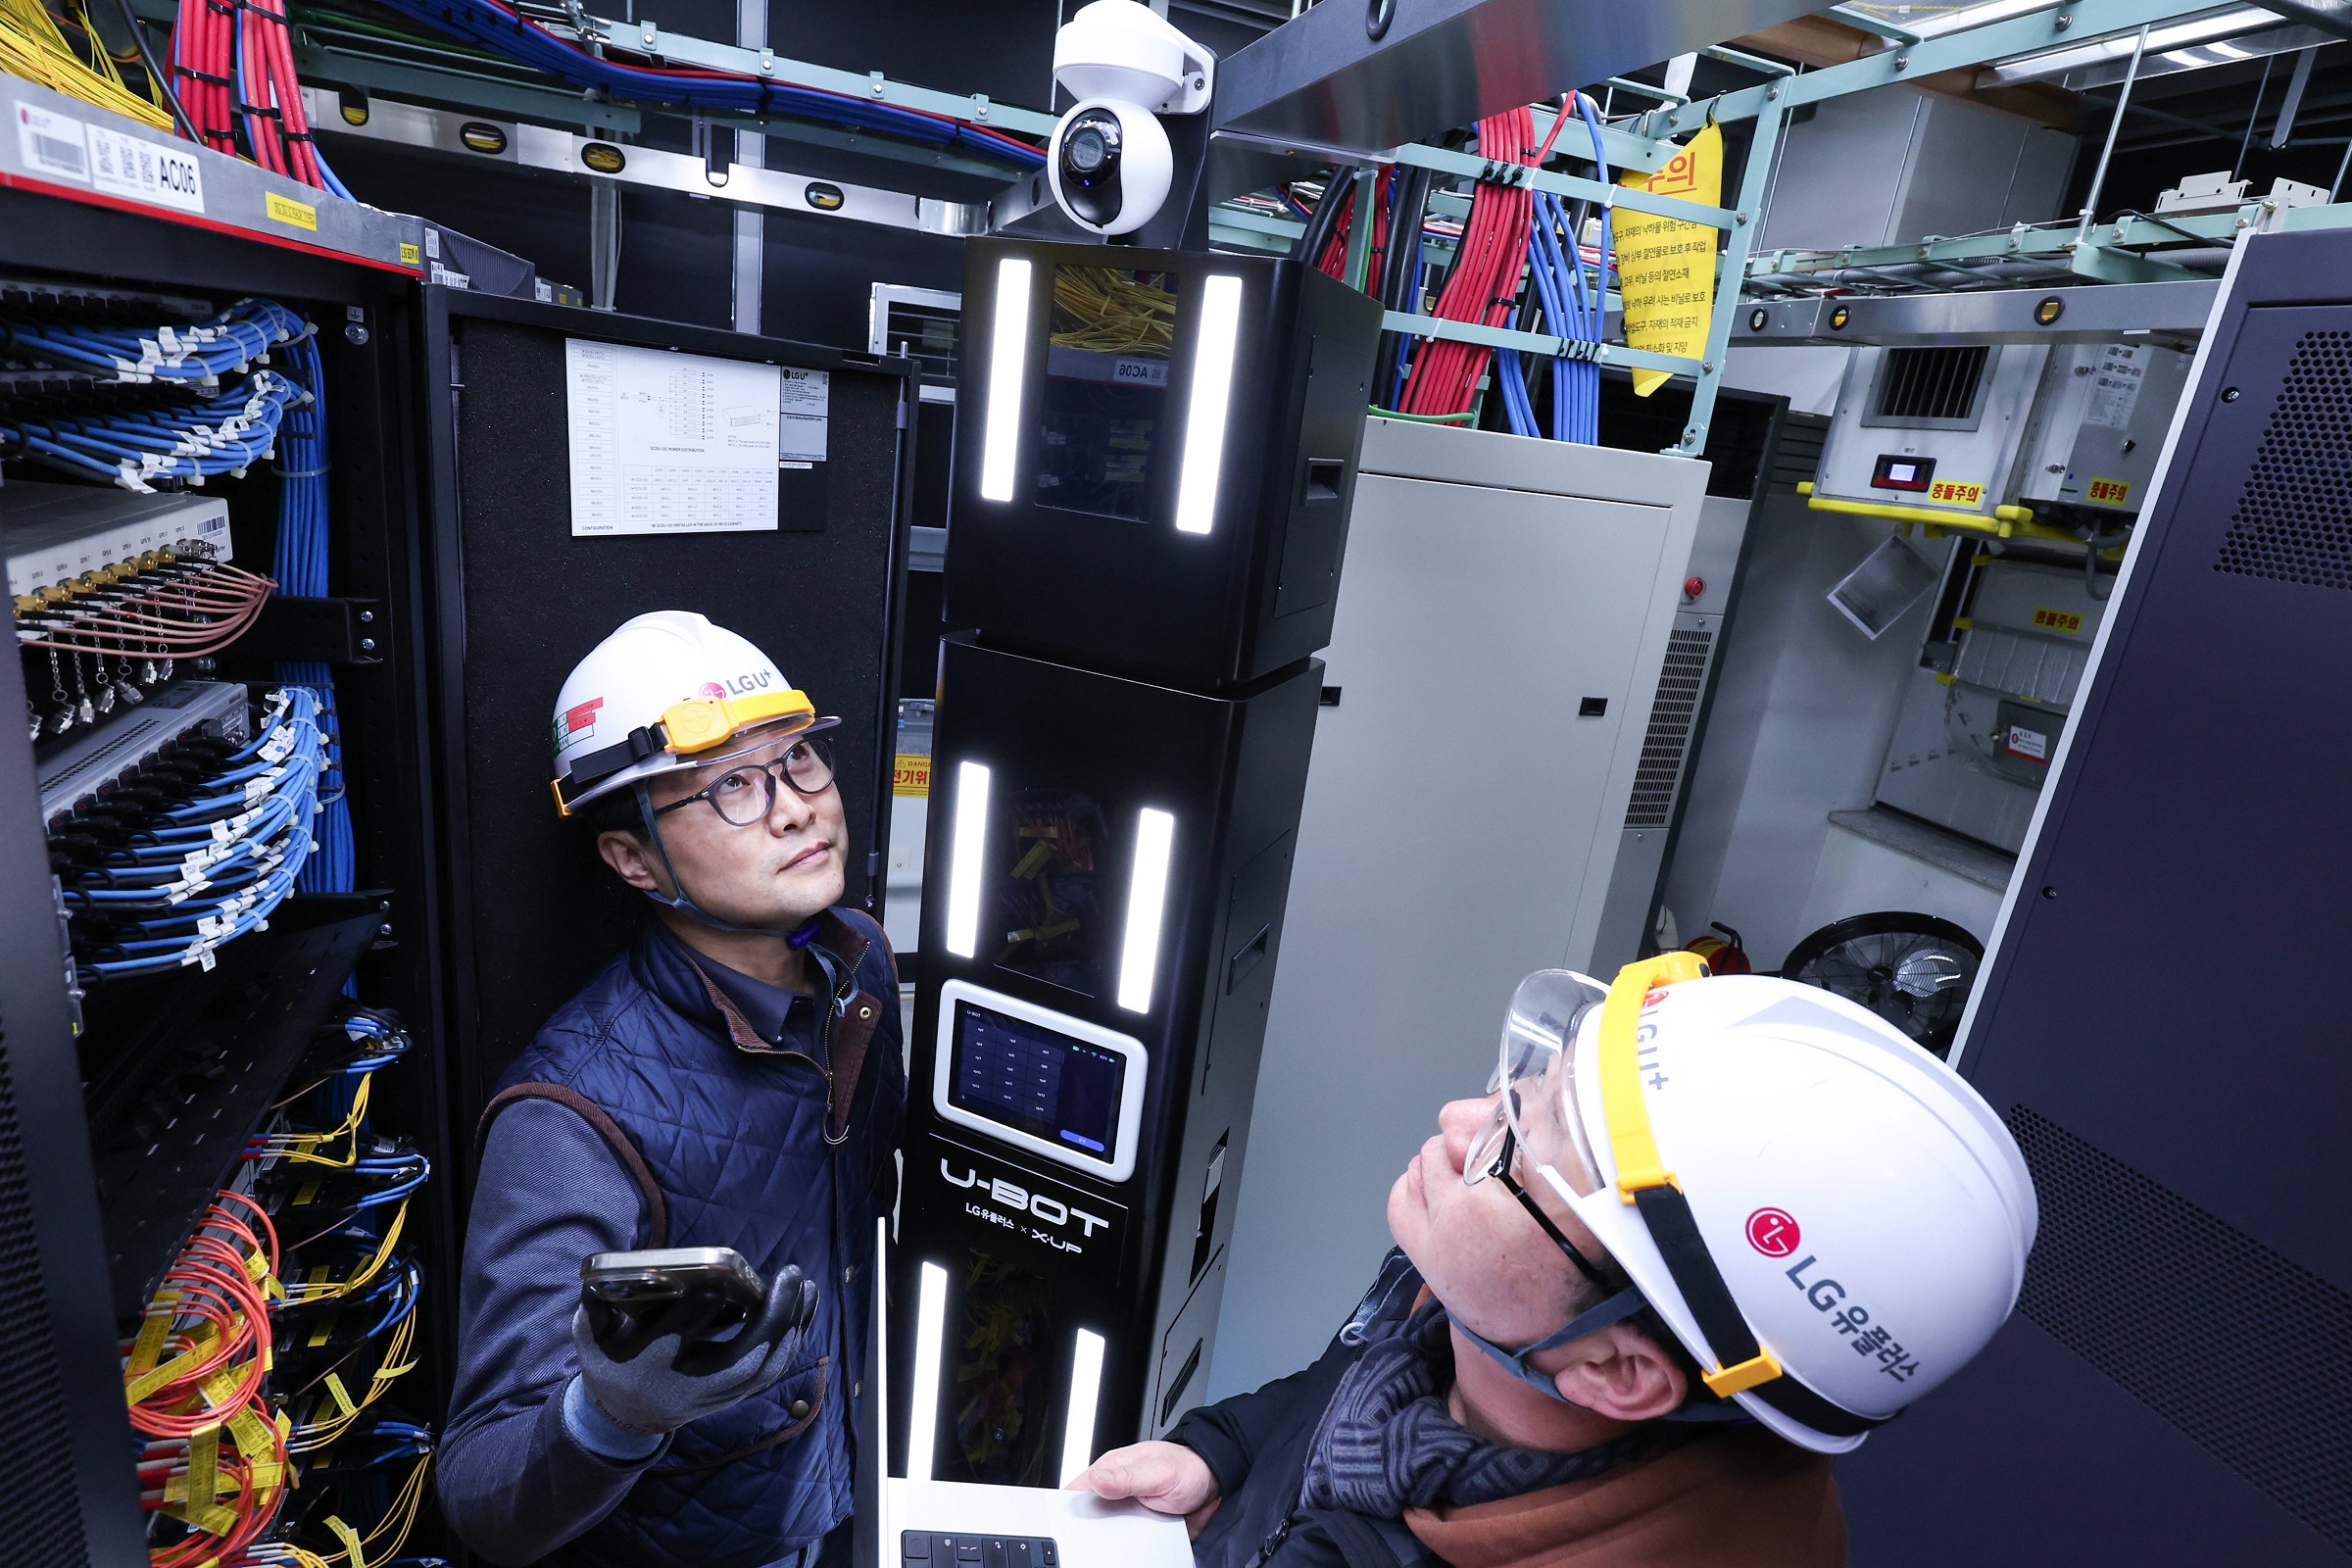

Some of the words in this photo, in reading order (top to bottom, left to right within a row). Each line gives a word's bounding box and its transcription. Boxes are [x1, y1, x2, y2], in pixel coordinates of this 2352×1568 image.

[160, 156, 196, 195] AC06
[1662, 219, 1676, 232] 위험
[1643, 246, 1668, 260] 절연물로
[1669, 244, 1683, 255] 보호
[1684, 242, 1691, 254] 후
[1691, 240, 1706, 253] 작업
[1635, 271, 1646, 284] 비닐
[1647, 270, 1661, 283] 등의
[1662, 268, 1690, 281] 절연소재
[1642, 295, 1655, 307] 우려
[1671, 293, 1690, 305] 비닐로
[1691, 291, 1705, 303] 보호
[1648, 318, 1668, 330] 자재의
[1670, 318, 1683, 329] 적재
[1684, 316, 1698, 328] 금지
[1932, 483, 1980, 503] 충돌주의
[2089, 480, 2128, 502] 충돌주의
[2034, 610, 2081, 630] 충돌주의
[940, 1158, 1109, 1237] U-BOT
[965, 1202, 1014, 1230] LG유플러스
[1786, 1255, 1920, 1383] LG유플러스
